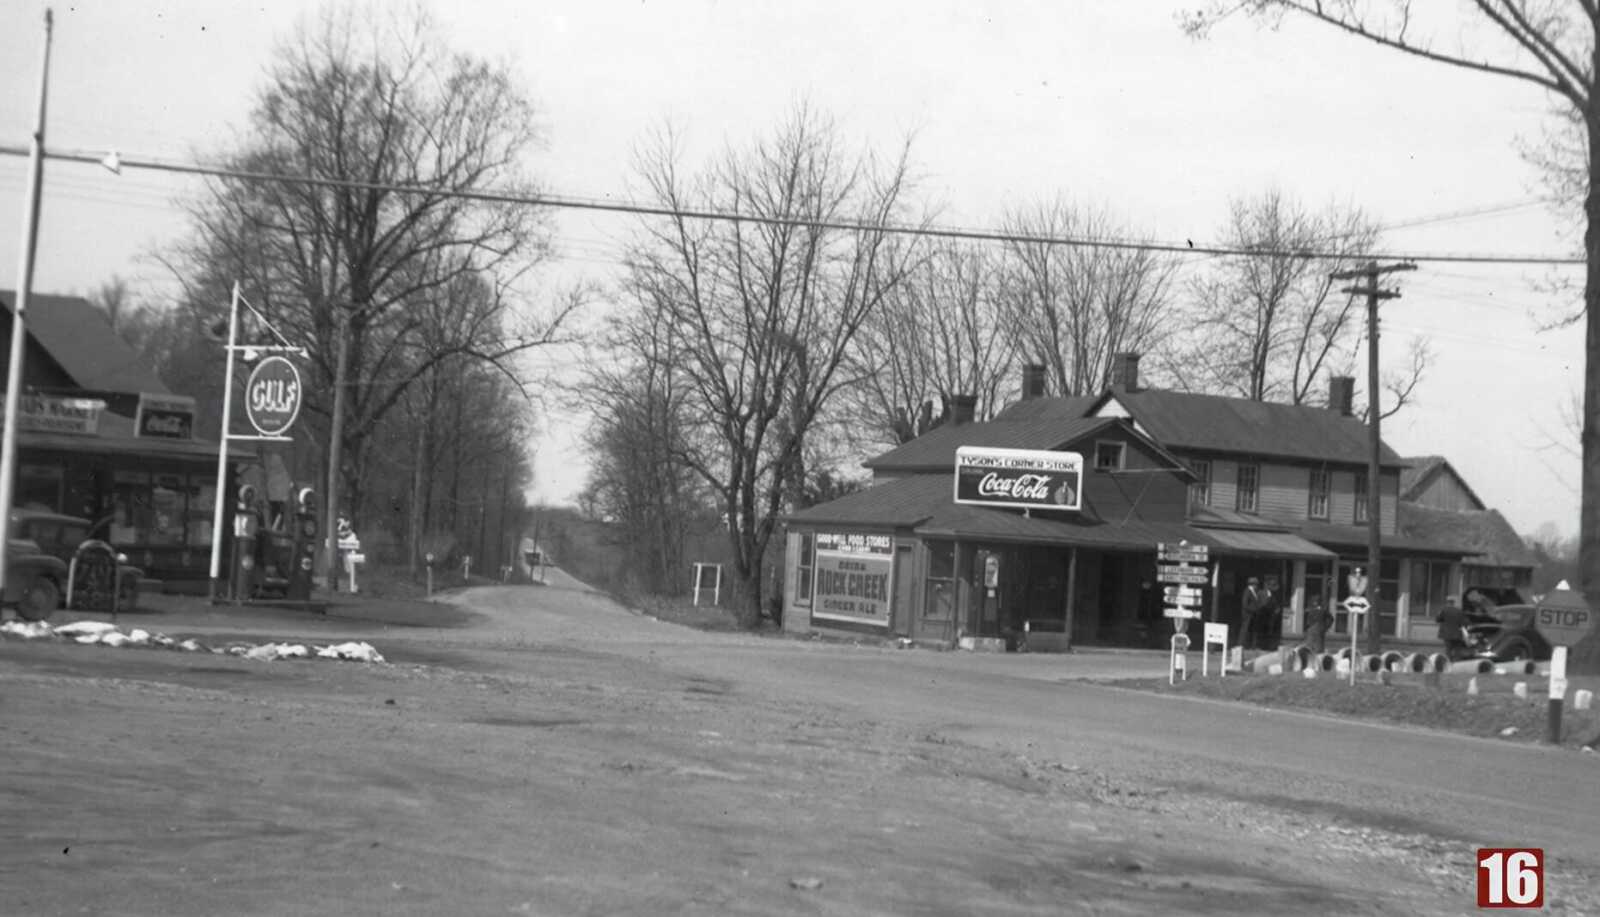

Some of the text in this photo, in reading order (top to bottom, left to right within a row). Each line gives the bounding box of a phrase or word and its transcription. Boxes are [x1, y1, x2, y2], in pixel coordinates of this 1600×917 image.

[253, 379, 297, 412] GULF
[1004, 458, 1044, 469] CORNER
[1046, 461, 1077, 471] STORE
[978, 472, 1053, 499] Coca-Cola
[817, 568, 888, 602] ROCK CREEK
[859, 602, 877, 615] ALE
[1540, 609, 1588, 626] STOP
